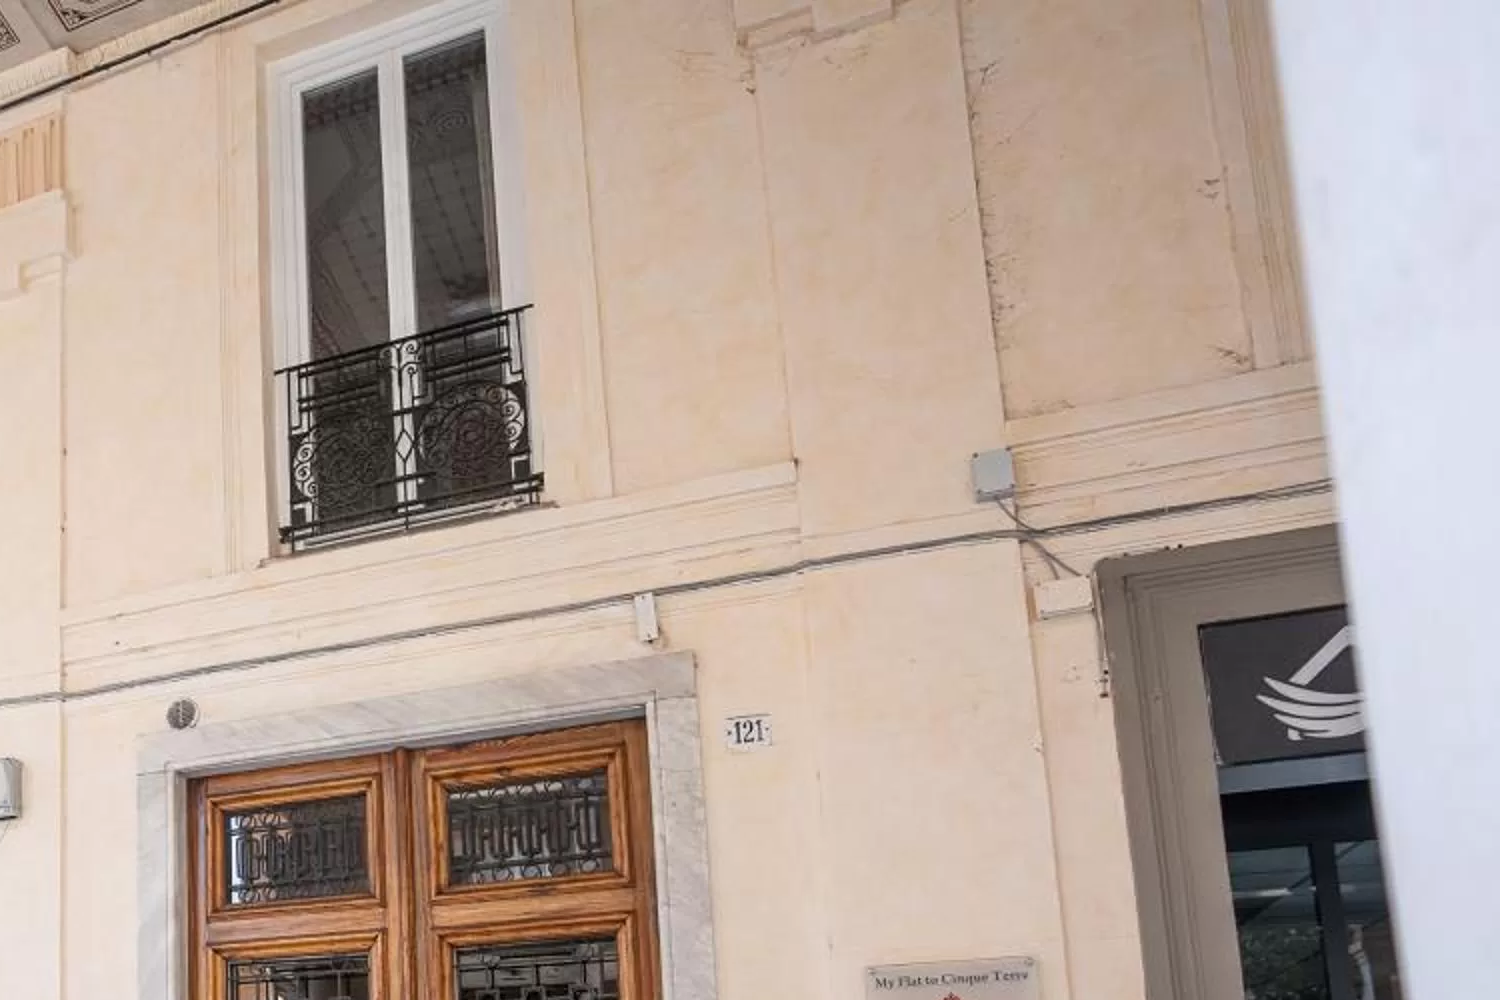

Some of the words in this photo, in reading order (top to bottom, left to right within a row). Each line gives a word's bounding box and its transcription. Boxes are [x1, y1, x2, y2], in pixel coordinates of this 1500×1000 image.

[734, 719, 764, 745] 121
[875, 976, 894, 991] My
[941, 973, 989, 988] Cinque
